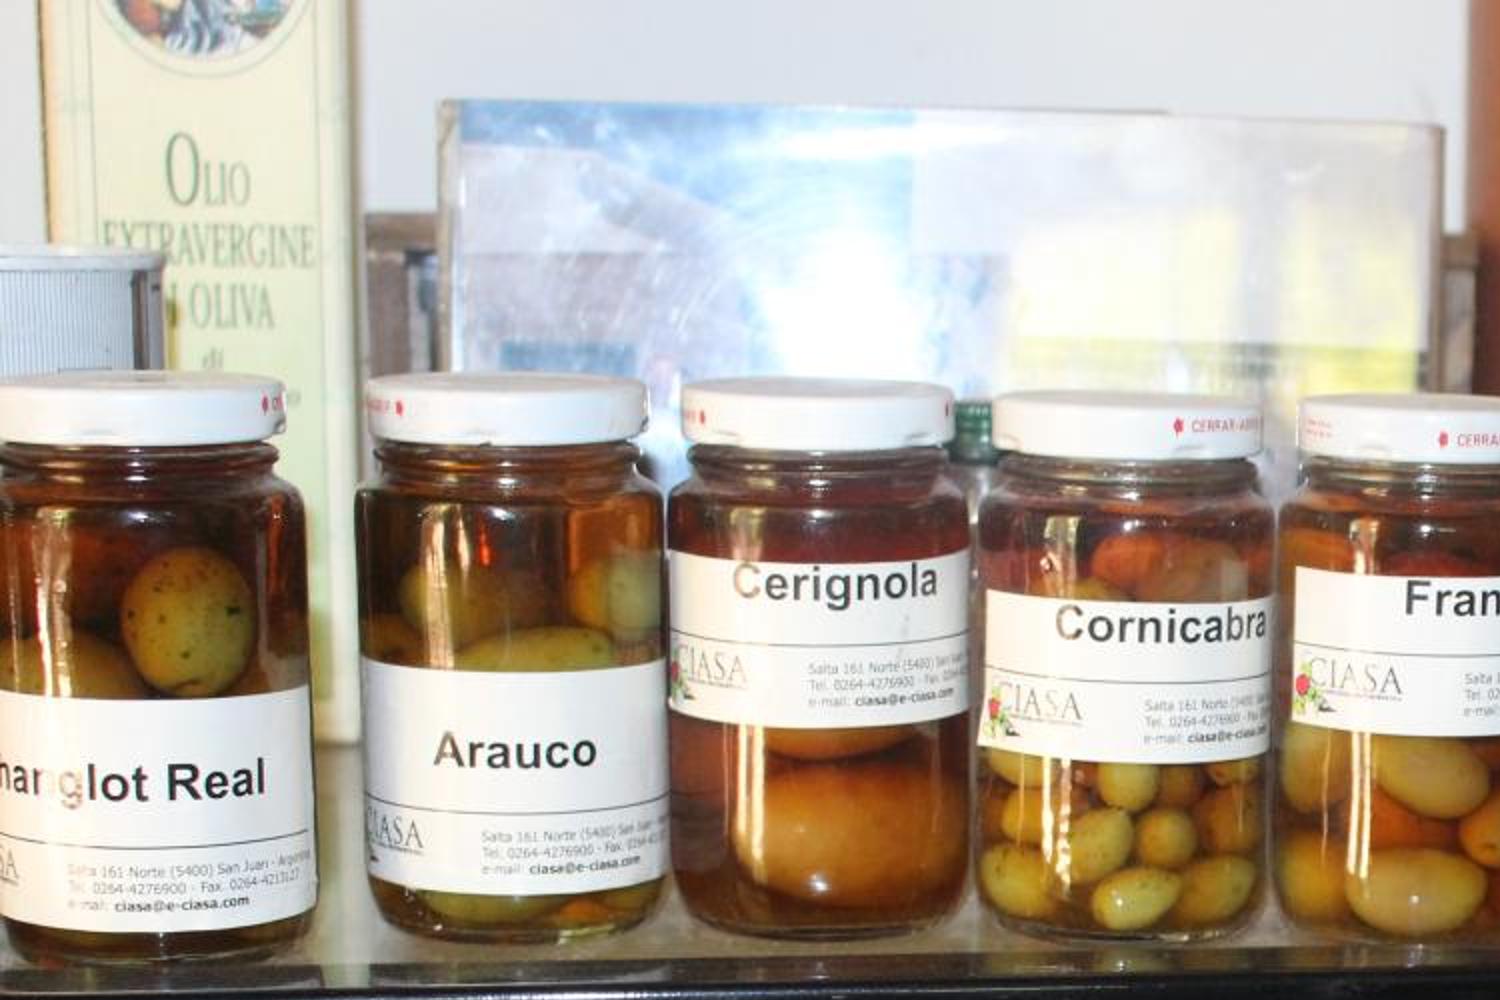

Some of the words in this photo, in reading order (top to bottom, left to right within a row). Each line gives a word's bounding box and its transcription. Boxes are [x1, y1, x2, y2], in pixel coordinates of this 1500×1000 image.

[190, 282, 275, 329] OLIVA
[733, 561, 938, 611] Cerignola
[1055, 603, 1267, 643] Cornicabra
[1308, 657, 1402, 697] CIASA
[433, 730, 598, 769] Arauco
[167, 757, 265, 801] Real
[543, 829, 576, 843] Norte
[129, 862, 165, 879] Norte
[170, 861, 214, 879] (5400)
[217, 858, 241, 875] San
[528, 854, 641, 876] ciasa@e-ciasa.com
[114, 894, 250, 914] ciasa@e-ciasa.com
